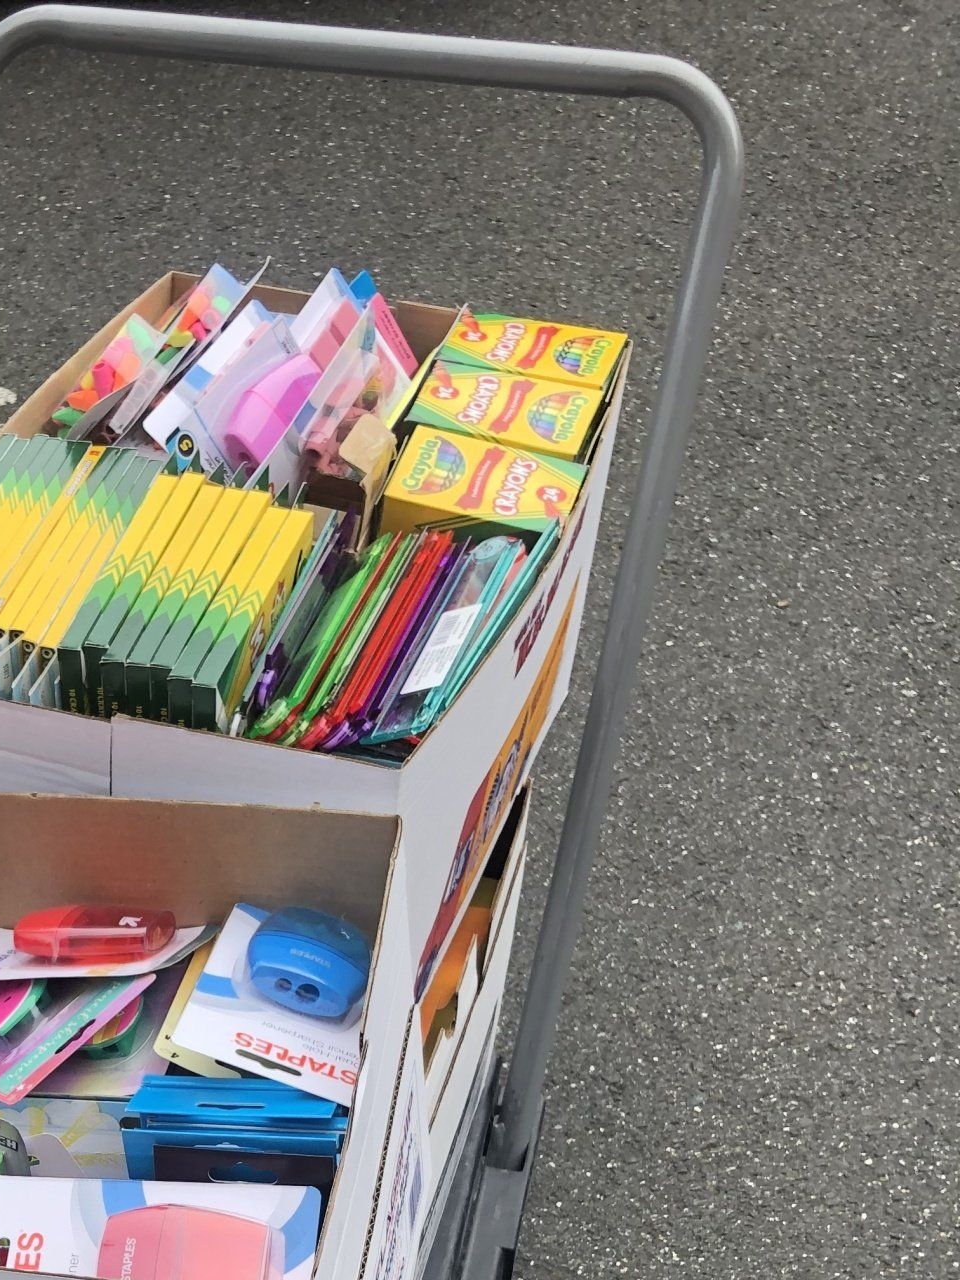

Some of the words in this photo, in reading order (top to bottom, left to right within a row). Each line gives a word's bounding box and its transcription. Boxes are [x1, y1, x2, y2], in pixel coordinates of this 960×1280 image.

[486, 323, 526, 362] CRAYONS
[580, 338, 613, 376] Crayola
[456, 375, 501, 425] CRAYONS
[554, 395, 589, 441] Crayola
[402, 438, 440, 491] Crayola
[494, 457, 539, 516] CRAYONS
[543, 487, 562, 502] 24
[261, 1020, 326, 1048] Sharpener
[327, 1042, 361, 1062] encil
[233, 1031, 359, 1085] STAPLES
